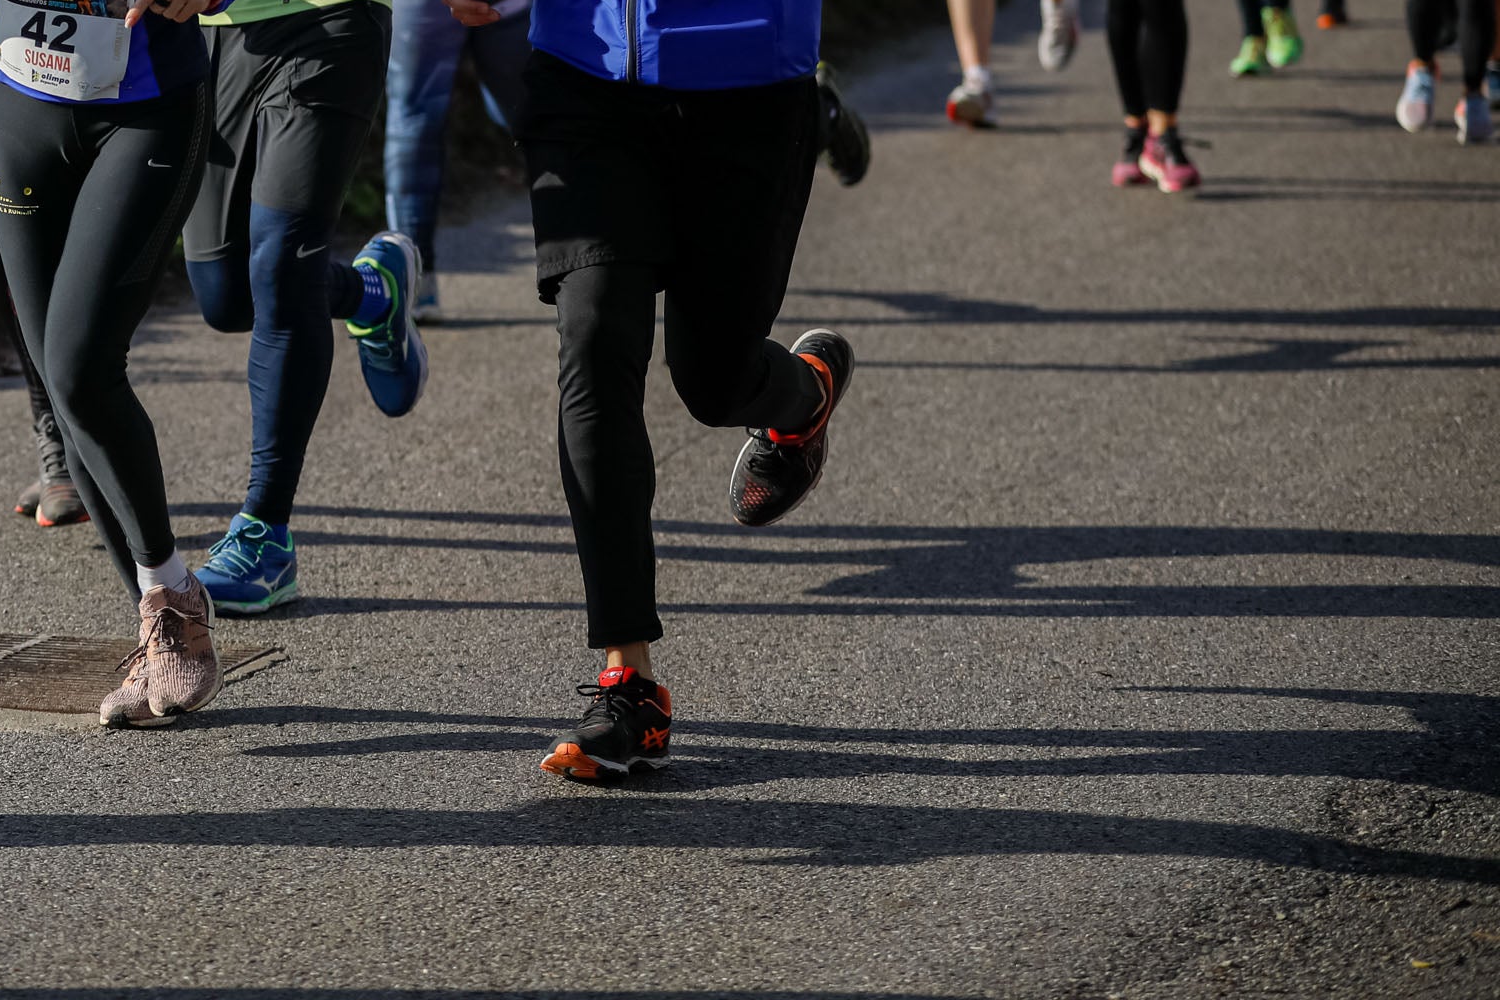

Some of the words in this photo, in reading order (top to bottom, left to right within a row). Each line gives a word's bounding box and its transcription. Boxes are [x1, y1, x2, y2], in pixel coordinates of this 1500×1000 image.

[20, 10, 78, 54] 42
[24, 48, 71, 73] SUSANA
[41, 73, 70, 85] olimpo
